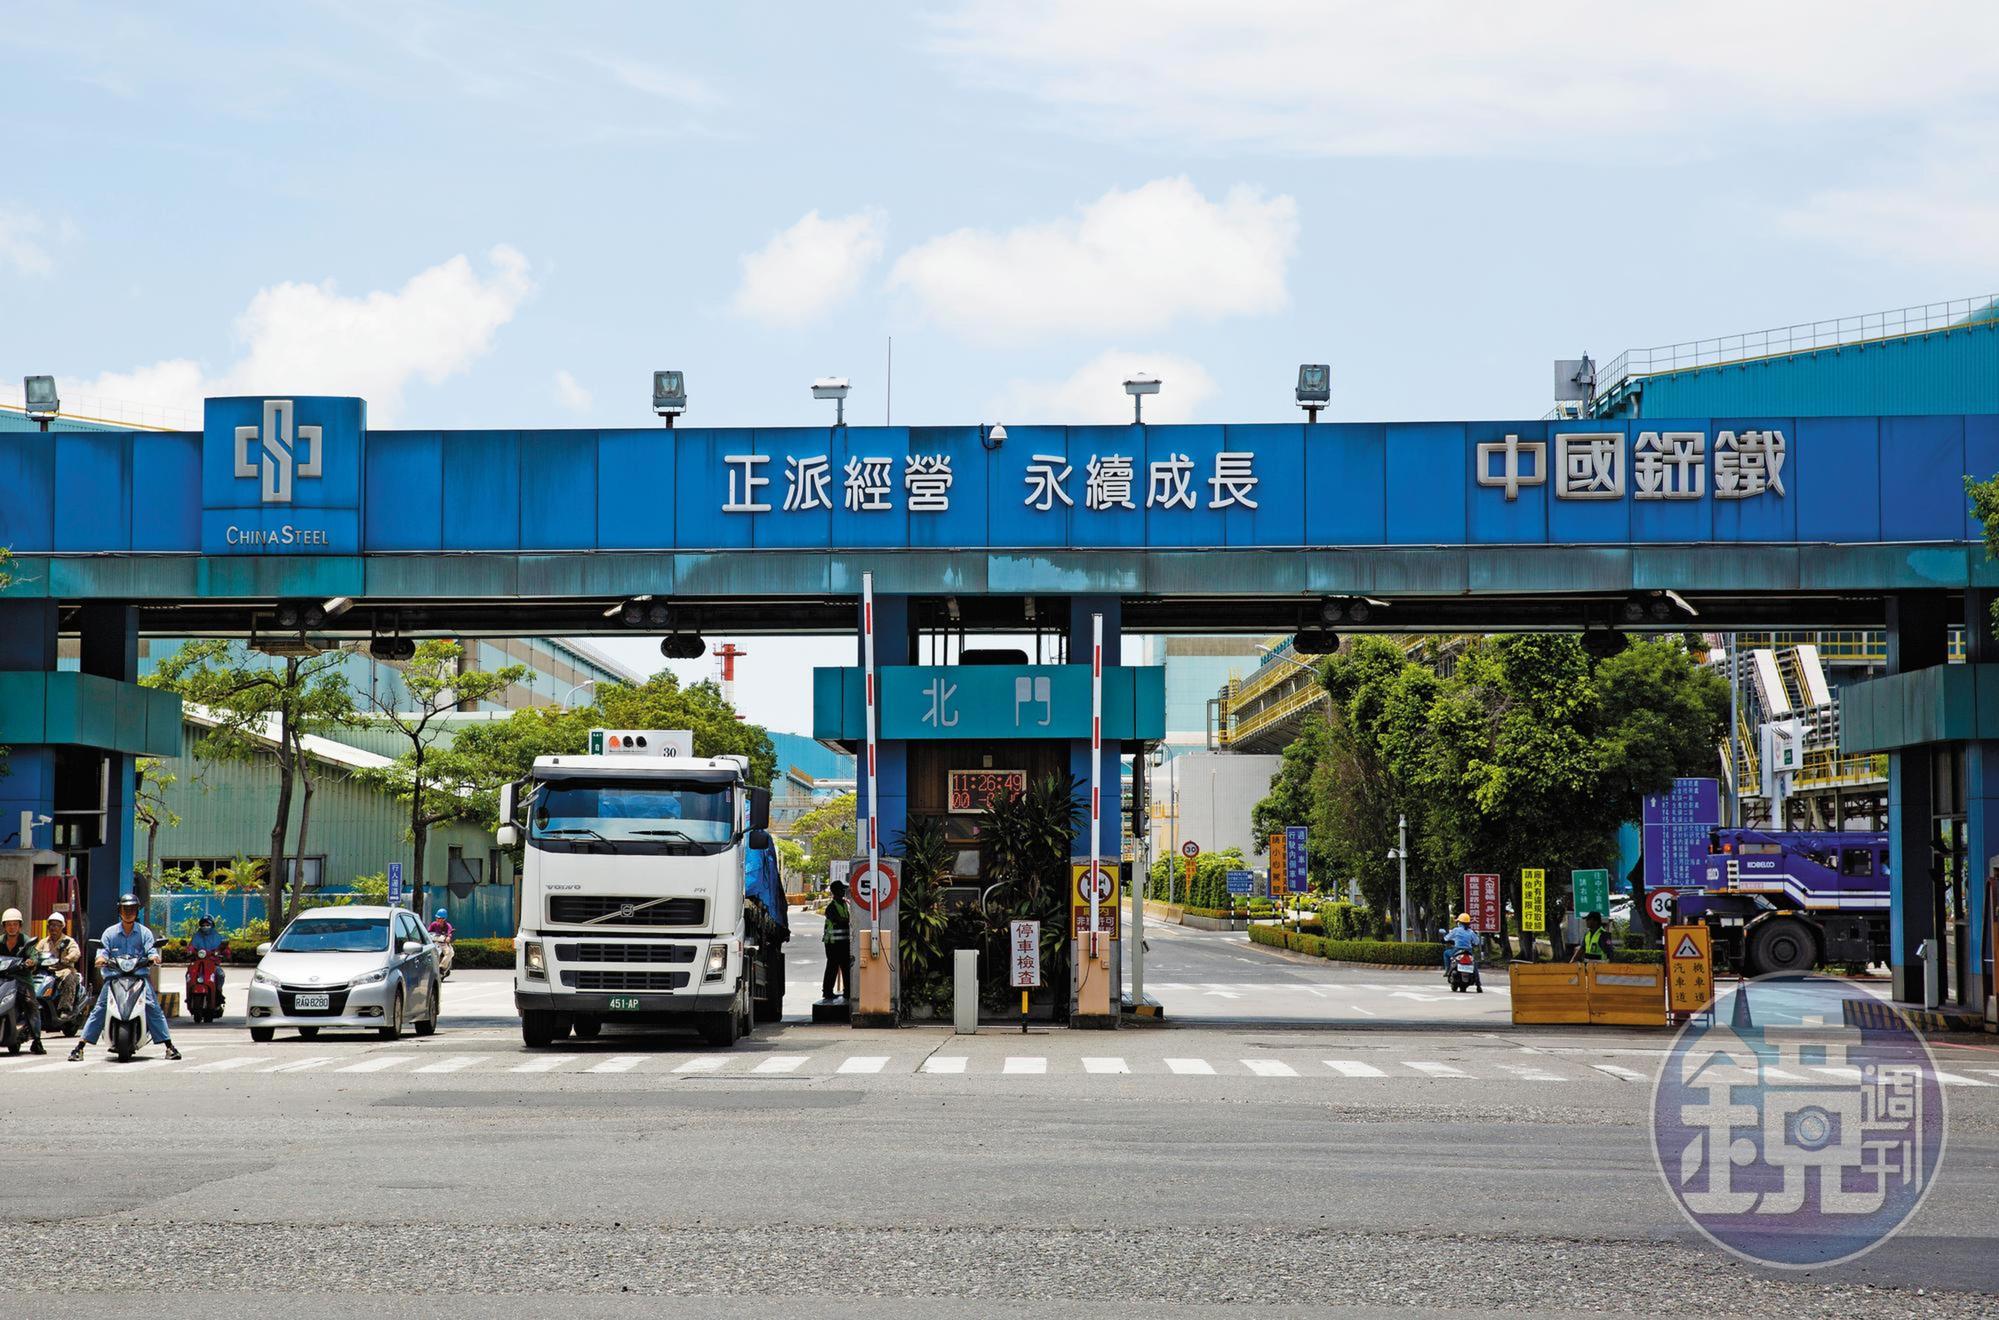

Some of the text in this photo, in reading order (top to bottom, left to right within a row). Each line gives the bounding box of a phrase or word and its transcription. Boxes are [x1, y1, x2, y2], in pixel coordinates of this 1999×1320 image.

[722, 454, 953, 513] 正派經營
[1024, 451, 1259, 511] 永續成長
[1477, 431, 1786, 500] 中國鋼鐵
[921, 677, 1051, 727] 北門
[953, 774, 1022, 791] 11:26:49
[1186, 846, 1197, 854] 30
[1747, 861, 1775, 869] KOBELCO
[1016, 923, 1035, 985] 停車檢查
[1673, 962, 1687, 1002] 汽車道
[1692, 962, 1706, 1002] 機車道
